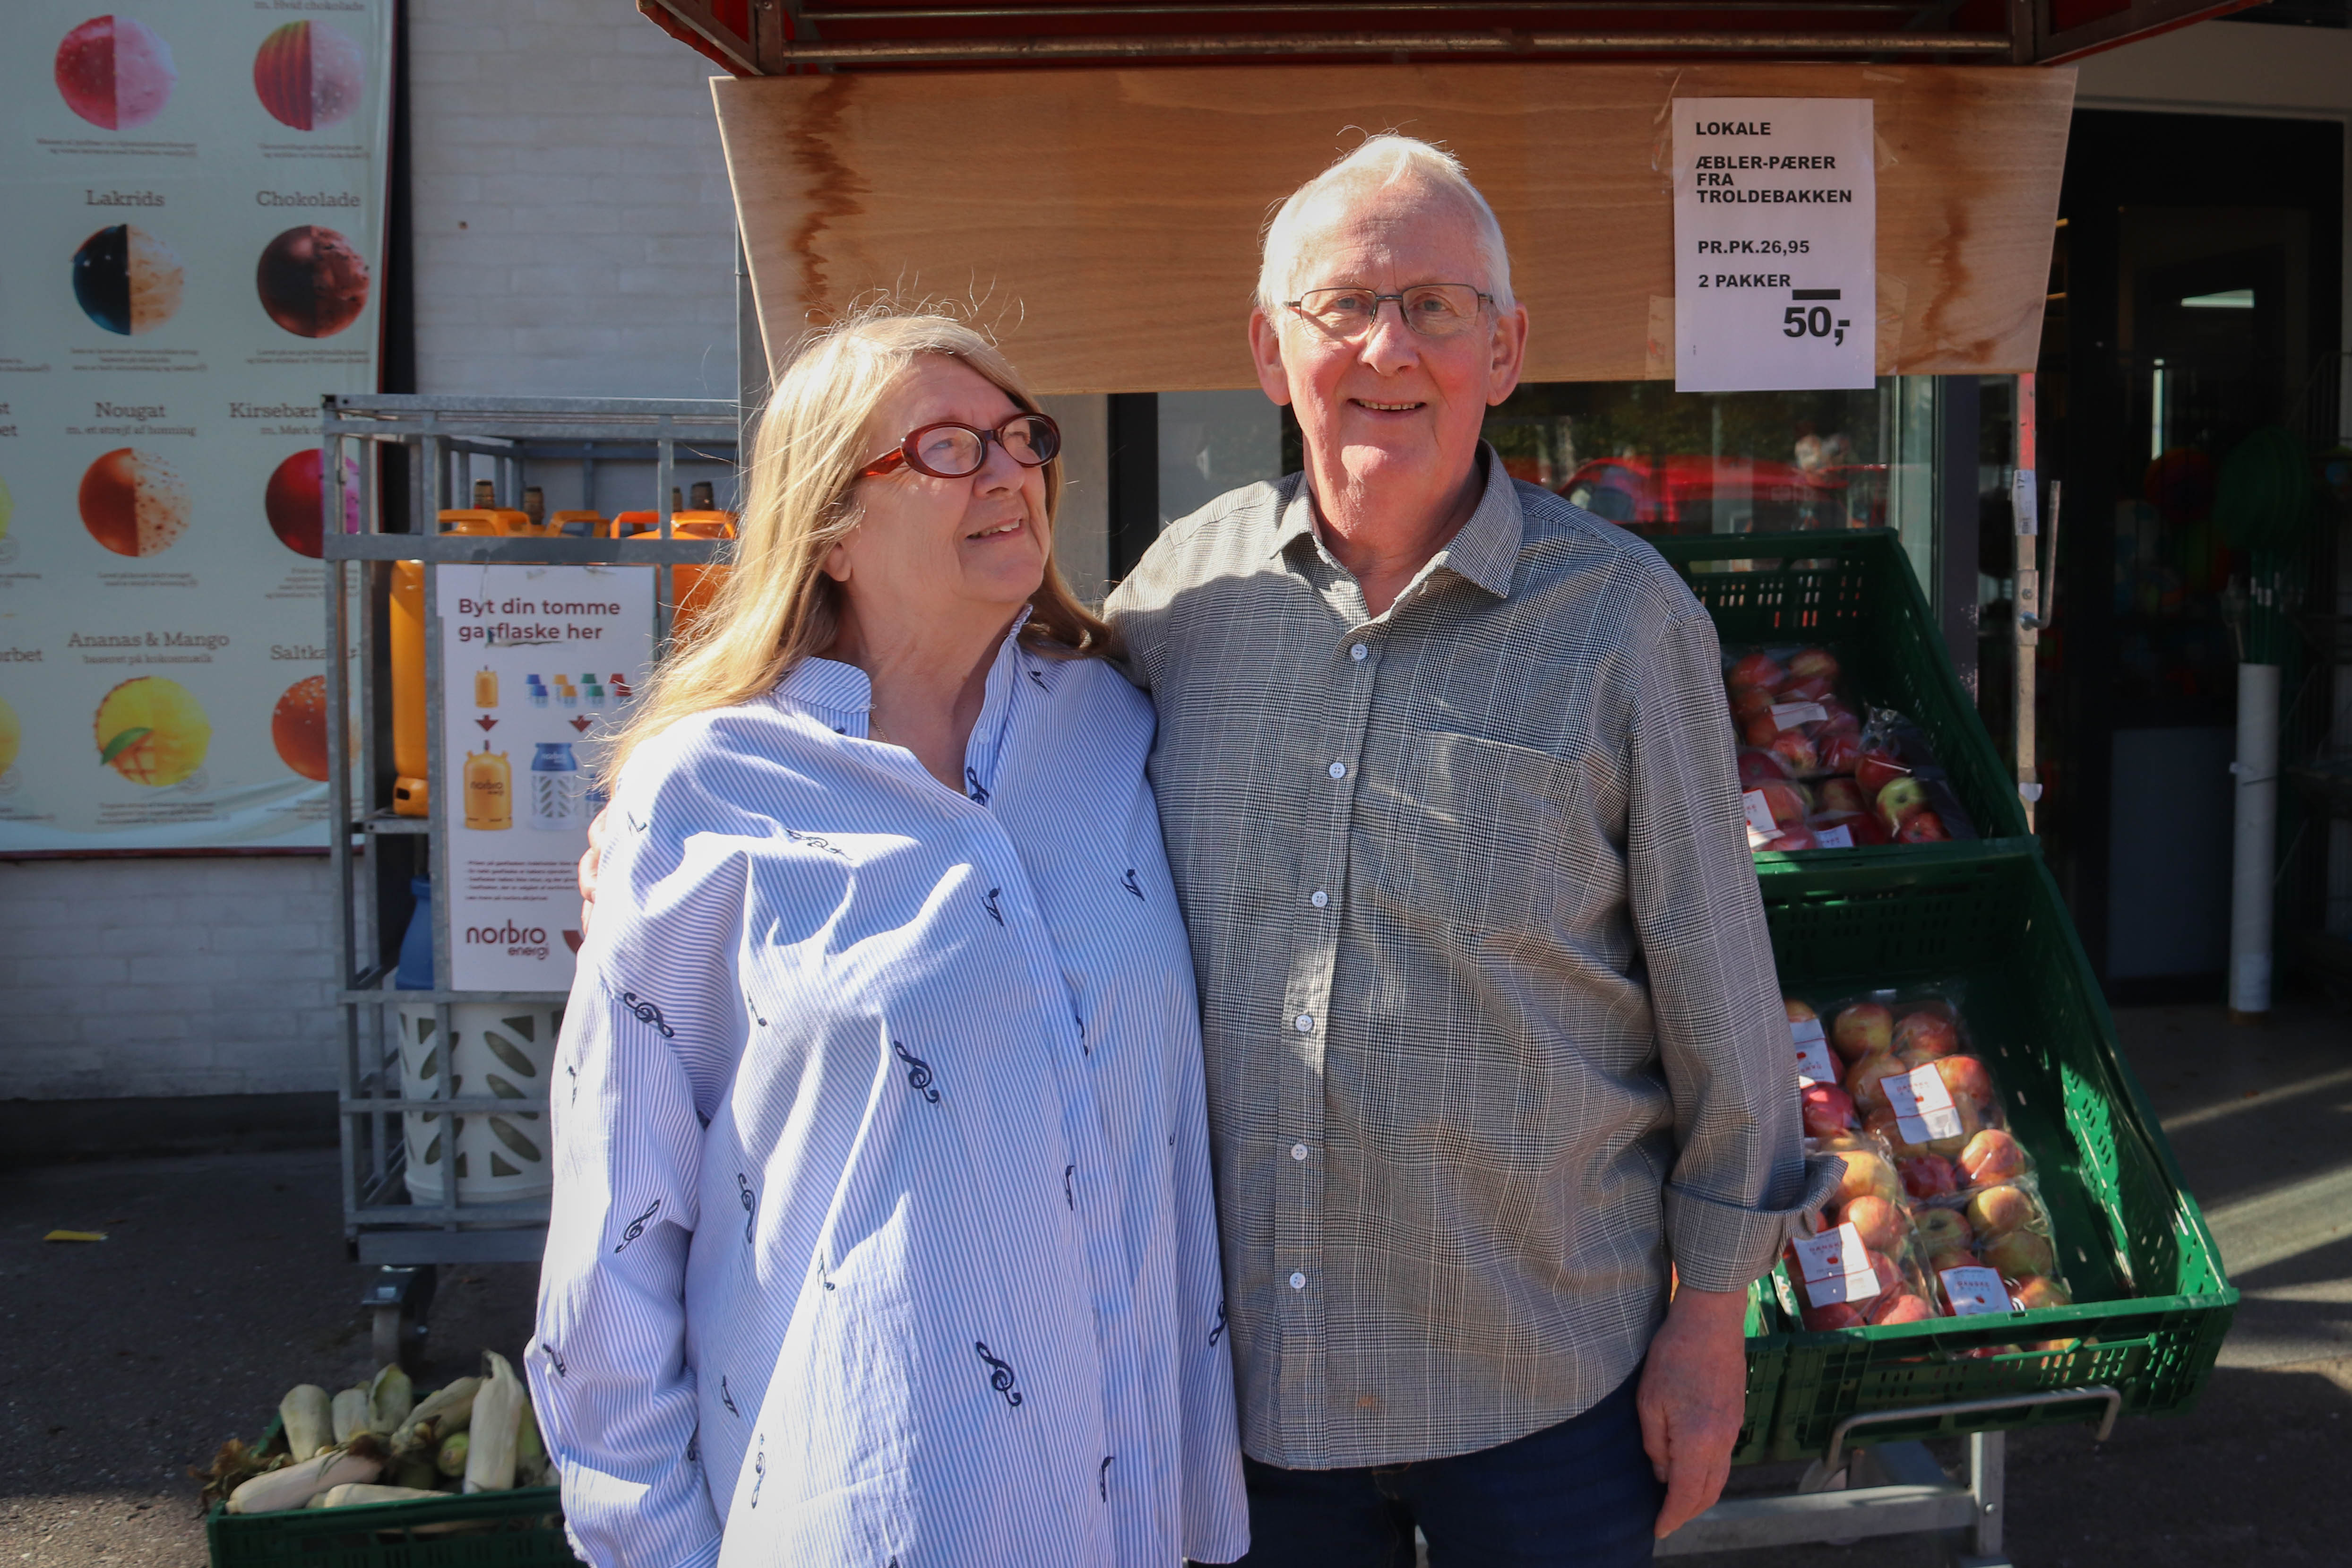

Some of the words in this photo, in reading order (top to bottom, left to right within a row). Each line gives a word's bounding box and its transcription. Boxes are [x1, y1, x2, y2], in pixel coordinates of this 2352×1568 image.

[1696, 122, 1772, 135] LOKALE
[1695, 156, 1836, 169] ÆBLER-PÆRER
[1697, 173, 1734, 186] FRA
[85, 190, 165, 206] Lakrids
[257, 190, 361, 207] Chokolade
[1697, 190, 1852, 203] TROLDEBAKKEN
[1698, 240, 1810, 256] PR.PK.26,95
[1698, 275, 1709, 287] 2
[1715, 275, 1791, 287] PAKKER
[1783, 306, 1850, 346] 50,-
[95, 402, 166, 421] Nougat
[229, 403, 319, 418] Kirsebær
[459, 599, 495, 617] Byt
[501, 598, 535, 613] din
[542, 600, 620, 614] tomme
[568, 623, 603, 639] her
[68, 632, 141, 647] Ananas
[145, 632, 159, 646] &
[164, 632, 230, 649] Mango
[466, 919, 546, 944] norbro
[508, 943, 549, 960] energi
